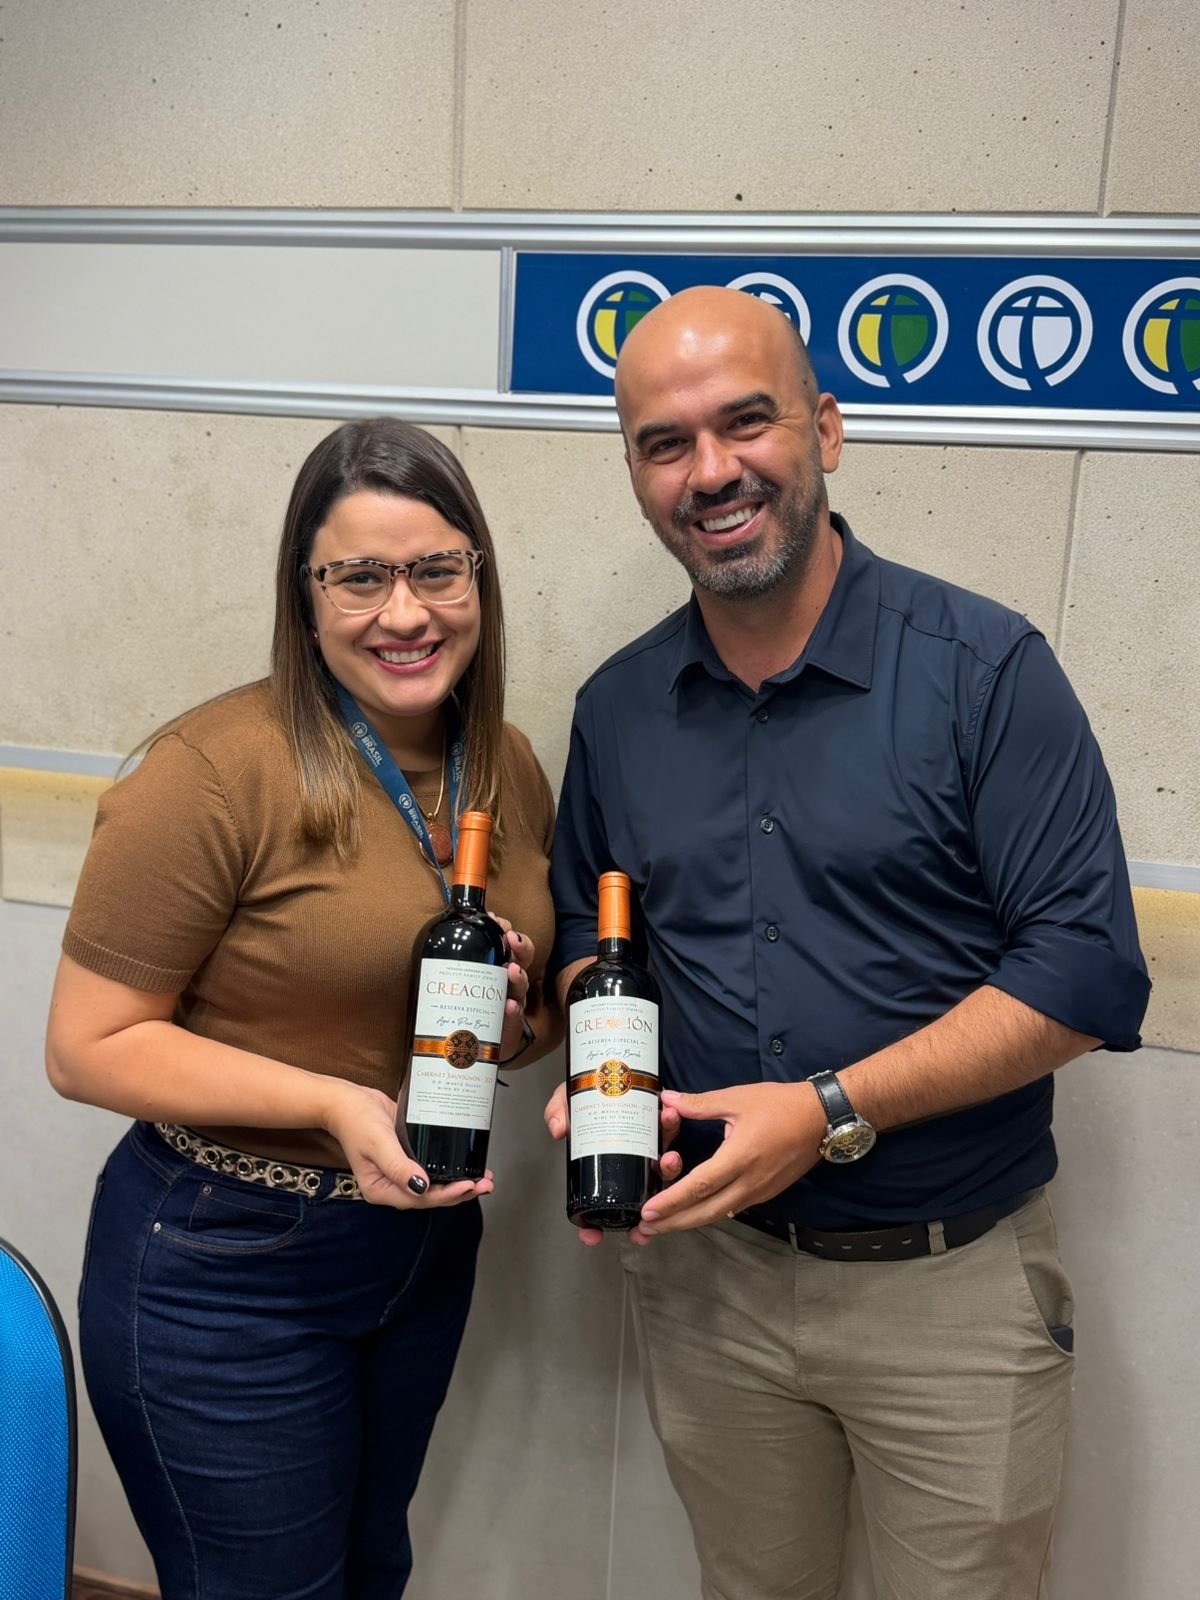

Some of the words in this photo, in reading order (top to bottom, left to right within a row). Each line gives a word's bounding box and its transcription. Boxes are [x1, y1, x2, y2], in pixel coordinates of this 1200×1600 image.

[362, 736, 382, 765] BRASIL
[426, 981, 503, 1001] CREACIÓN
[440, 1004, 465, 1012] RESERVA
[466, 1007, 490, 1015] ESPECIAL
[575, 1015, 653, 1034] CREACIÓN
[613, 1037, 639, 1045] ESPECIAL
[416, 1071, 446, 1079] CABERNET
[447, 1074, 481, 1082] SAUVIGNON
[575, 1103, 600, 1113] CABERNET
